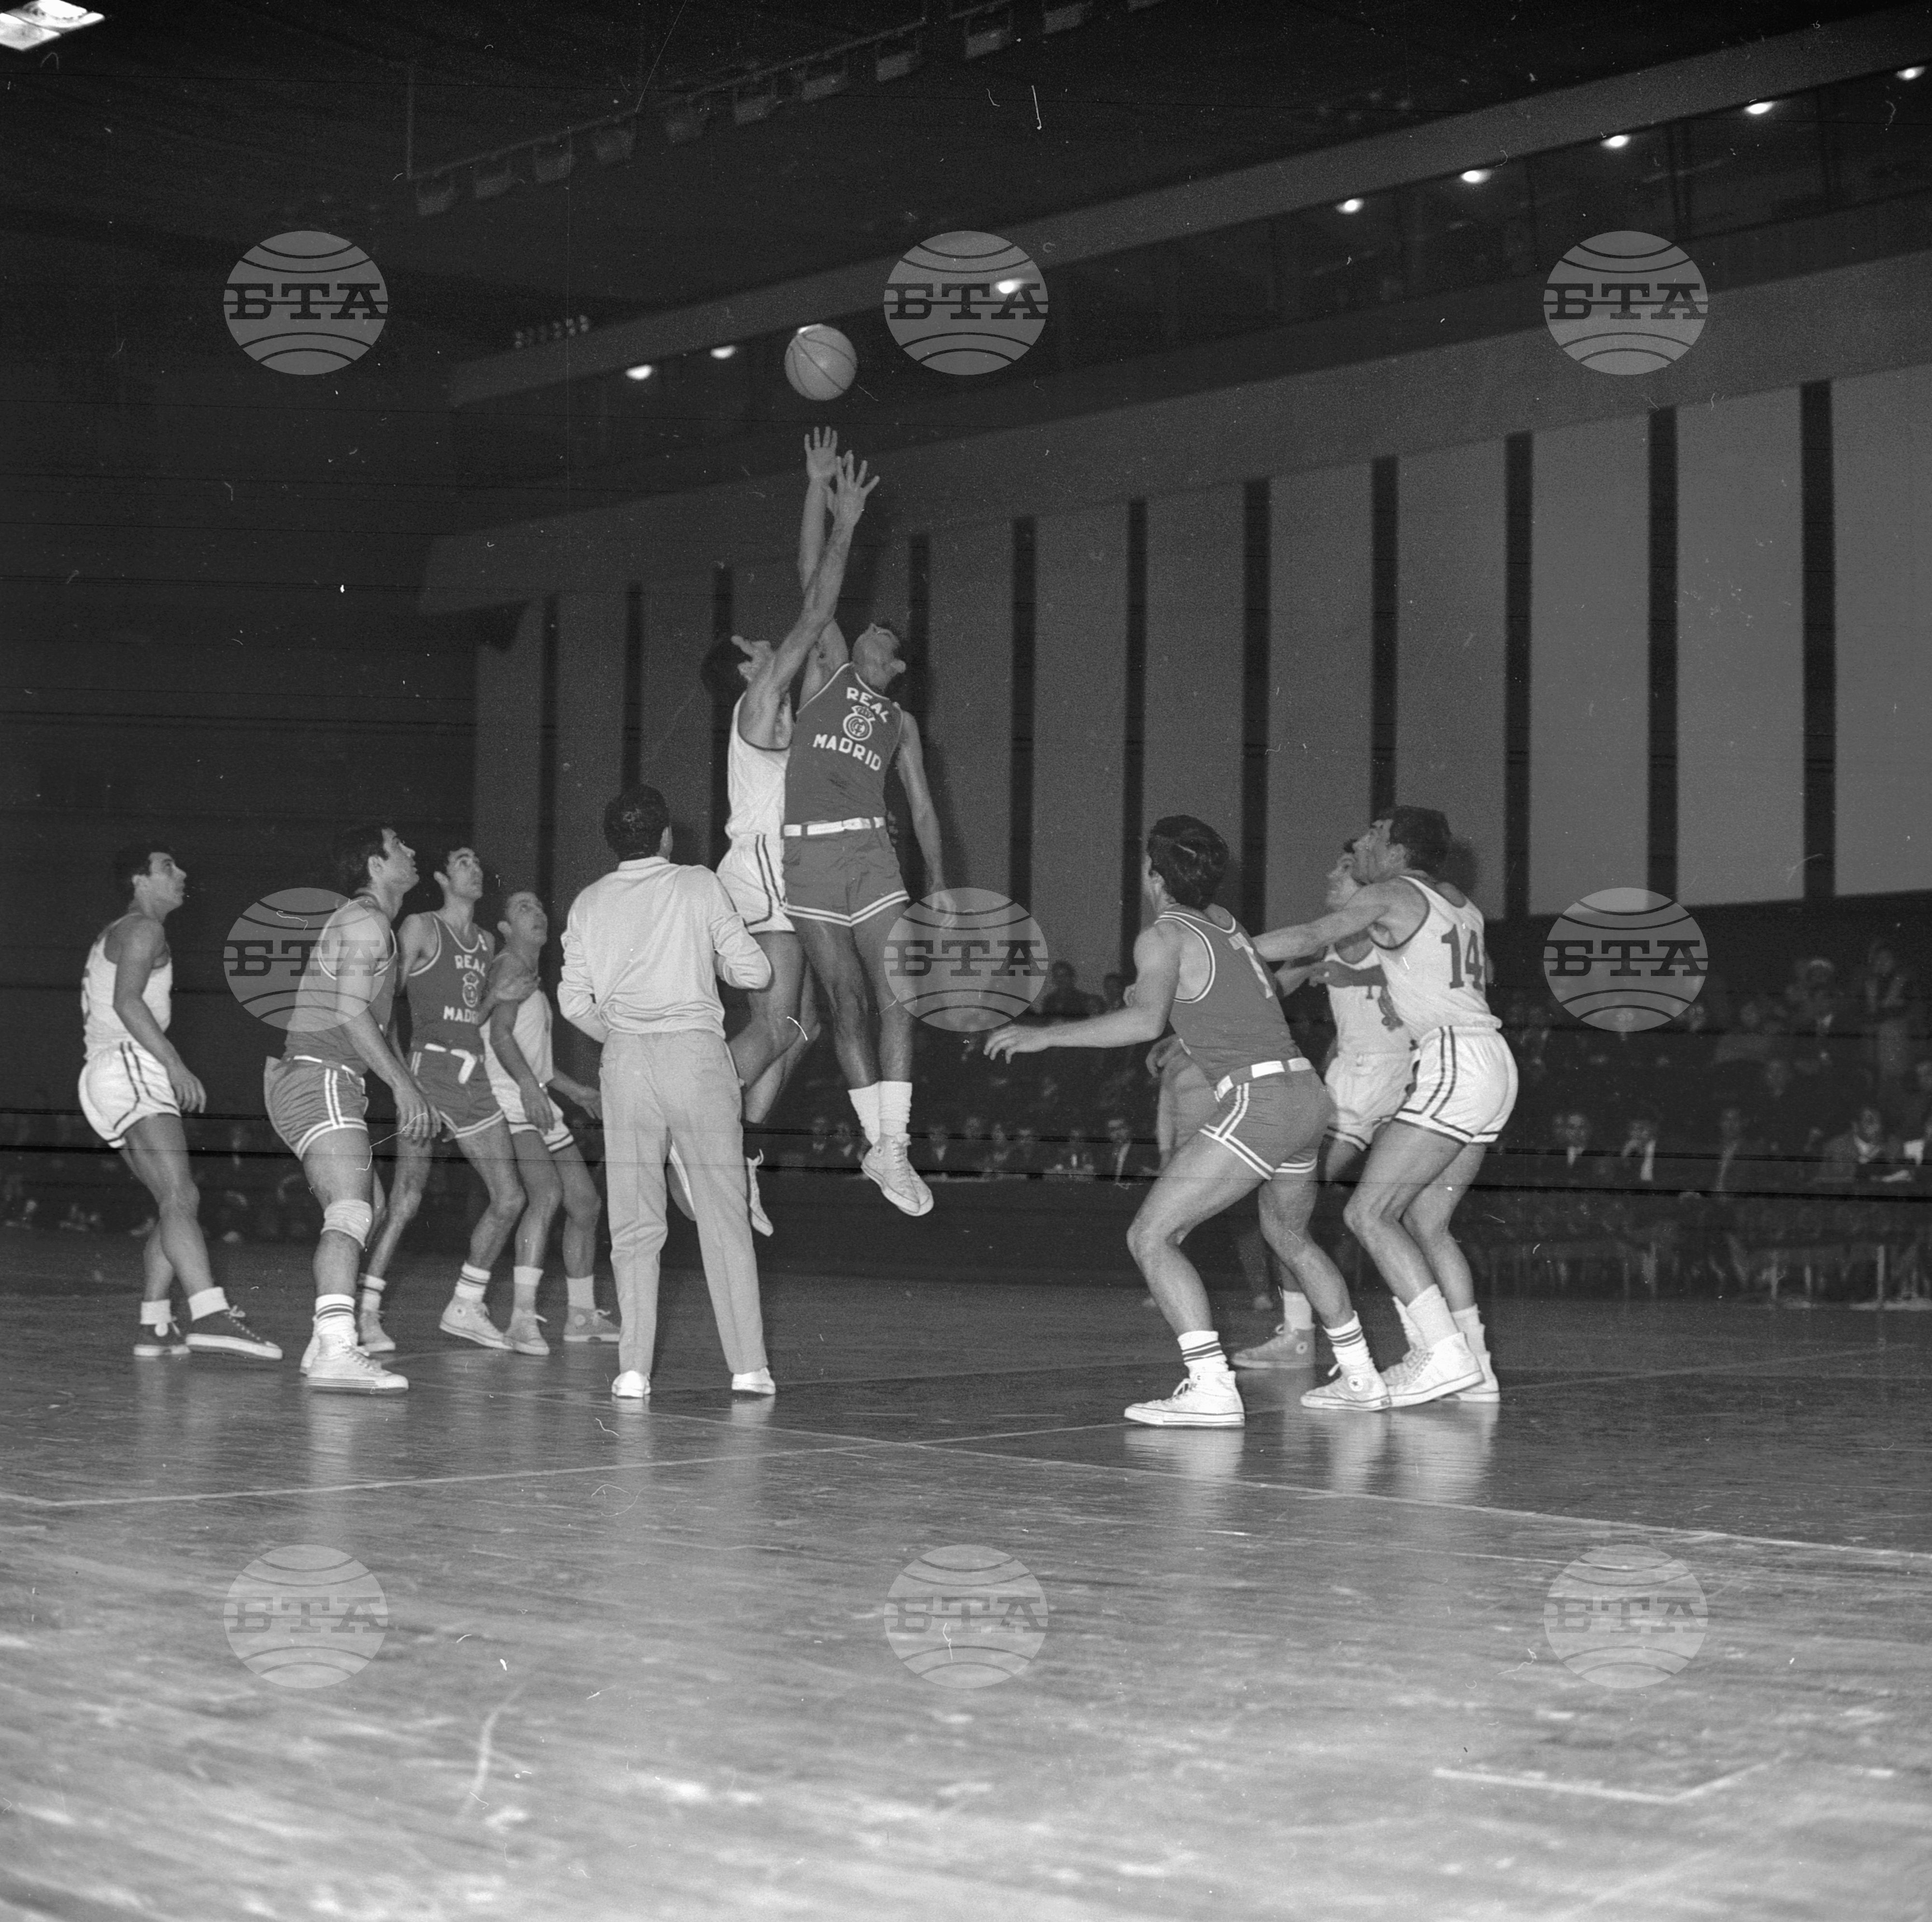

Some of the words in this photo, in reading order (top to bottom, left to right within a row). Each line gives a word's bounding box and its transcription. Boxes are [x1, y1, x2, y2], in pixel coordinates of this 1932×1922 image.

[846, 687, 889, 723] REAL
[812, 734, 882, 771] MADRID
[454, 954, 485, 976] REAL
[1441, 923, 1484, 991] 14
